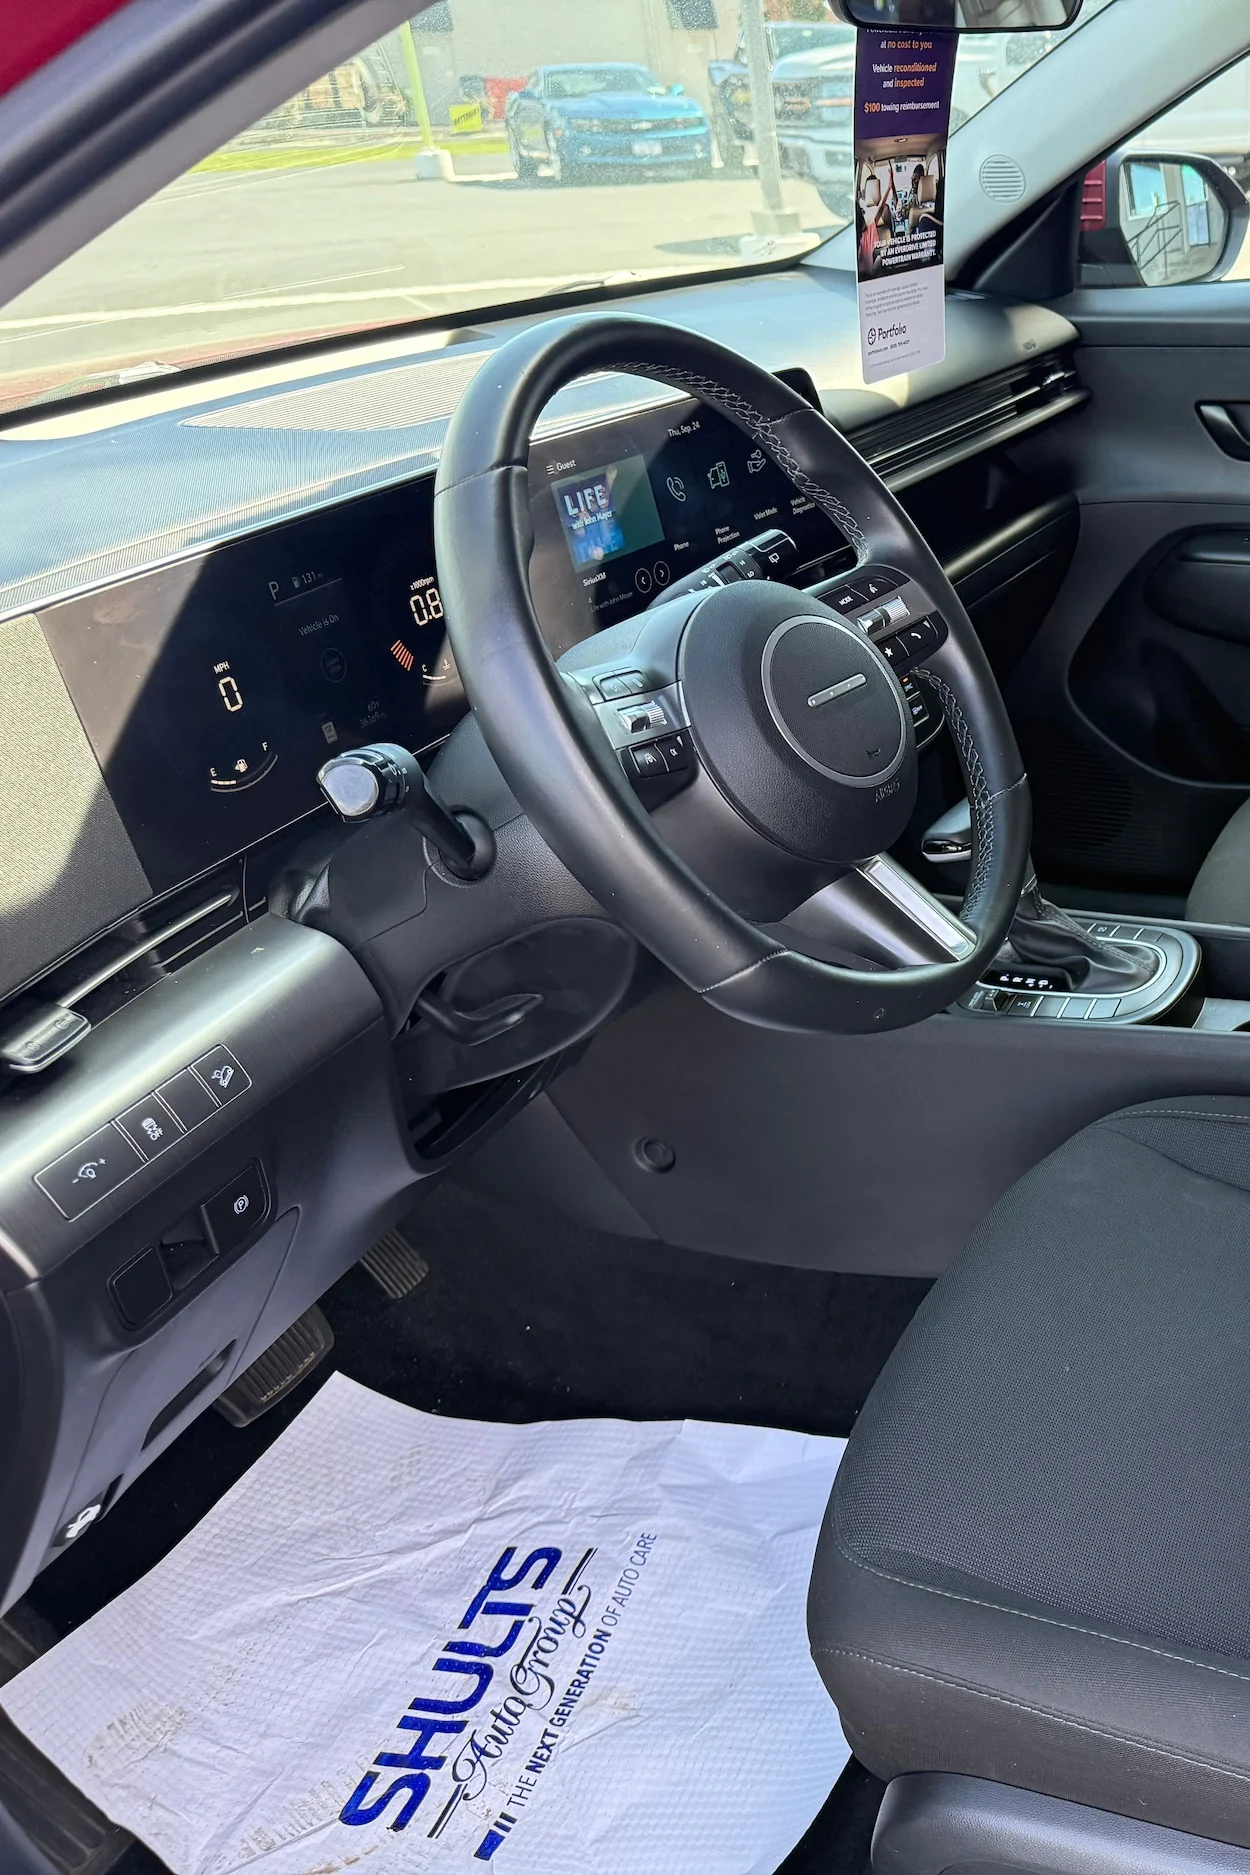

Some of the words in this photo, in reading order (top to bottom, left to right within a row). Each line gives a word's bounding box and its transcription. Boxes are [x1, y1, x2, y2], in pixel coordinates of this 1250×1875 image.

[880, 40, 886, 49] at
[897, 40, 911, 48] cost
[912, 40, 919, 48] to
[920, 41, 932, 50] you
[872, 63, 893, 74] Vehicle
[894, 62, 938, 73] reconditioned
[883, 78, 894, 88] and
[894, 77, 924, 89] inspected
[864, 102, 881, 114] $100
[881, 102, 900, 113] towing
[900, 101, 940, 110] reimbursement
[874, 240, 887, 248] YOUR
[888, 236, 906, 246] VEHICLE
[910, 230, 936, 242] PROTECTED
[887, 248, 895, 256] AN
[919, 240, 936, 249] LIMITED
[882, 254, 912, 266] POWERTRAIN
[878, 322, 907, 341] Portfolio
[692, 421, 700, 431] 24
[556, 459, 576, 472] Guest
[564, 484, 607, 516] LIFE
[585, 516, 598, 526] John
[596, 510, 613, 522] Mayer
[714, 526, 730, 536] Phone
[717, 531, 740, 544] Projection
[674, 541, 690, 552] Phone
[302, 571, 317, 584] 131
[582, 571, 607, 587] SiriusXM
[268, 580, 280, 600] P
[410, 588, 444, 627] 0.8
[298, 620, 322, 636] Vehicle
[322, 618, 330, 626] is
[328, 614, 340, 624] On
[213, 660, 230, 675] MPH
[422, 664, 428, 673] C
[218, 676, 244, 712] 0
[262, 741, 268, 752] F
[210, 767, 218, 778] E
[507, 1774, 538, 1807] THE
[525, 1728, 560, 1775] NEXT
[550, 1628, 612, 1728] GENERATION
[601, 1605, 622, 1627] OF
[612, 1567, 640, 1606] AUTO
[638, 1532, 658, 1566] CARE
[338, 1546, 563, 1832] SHULTS
